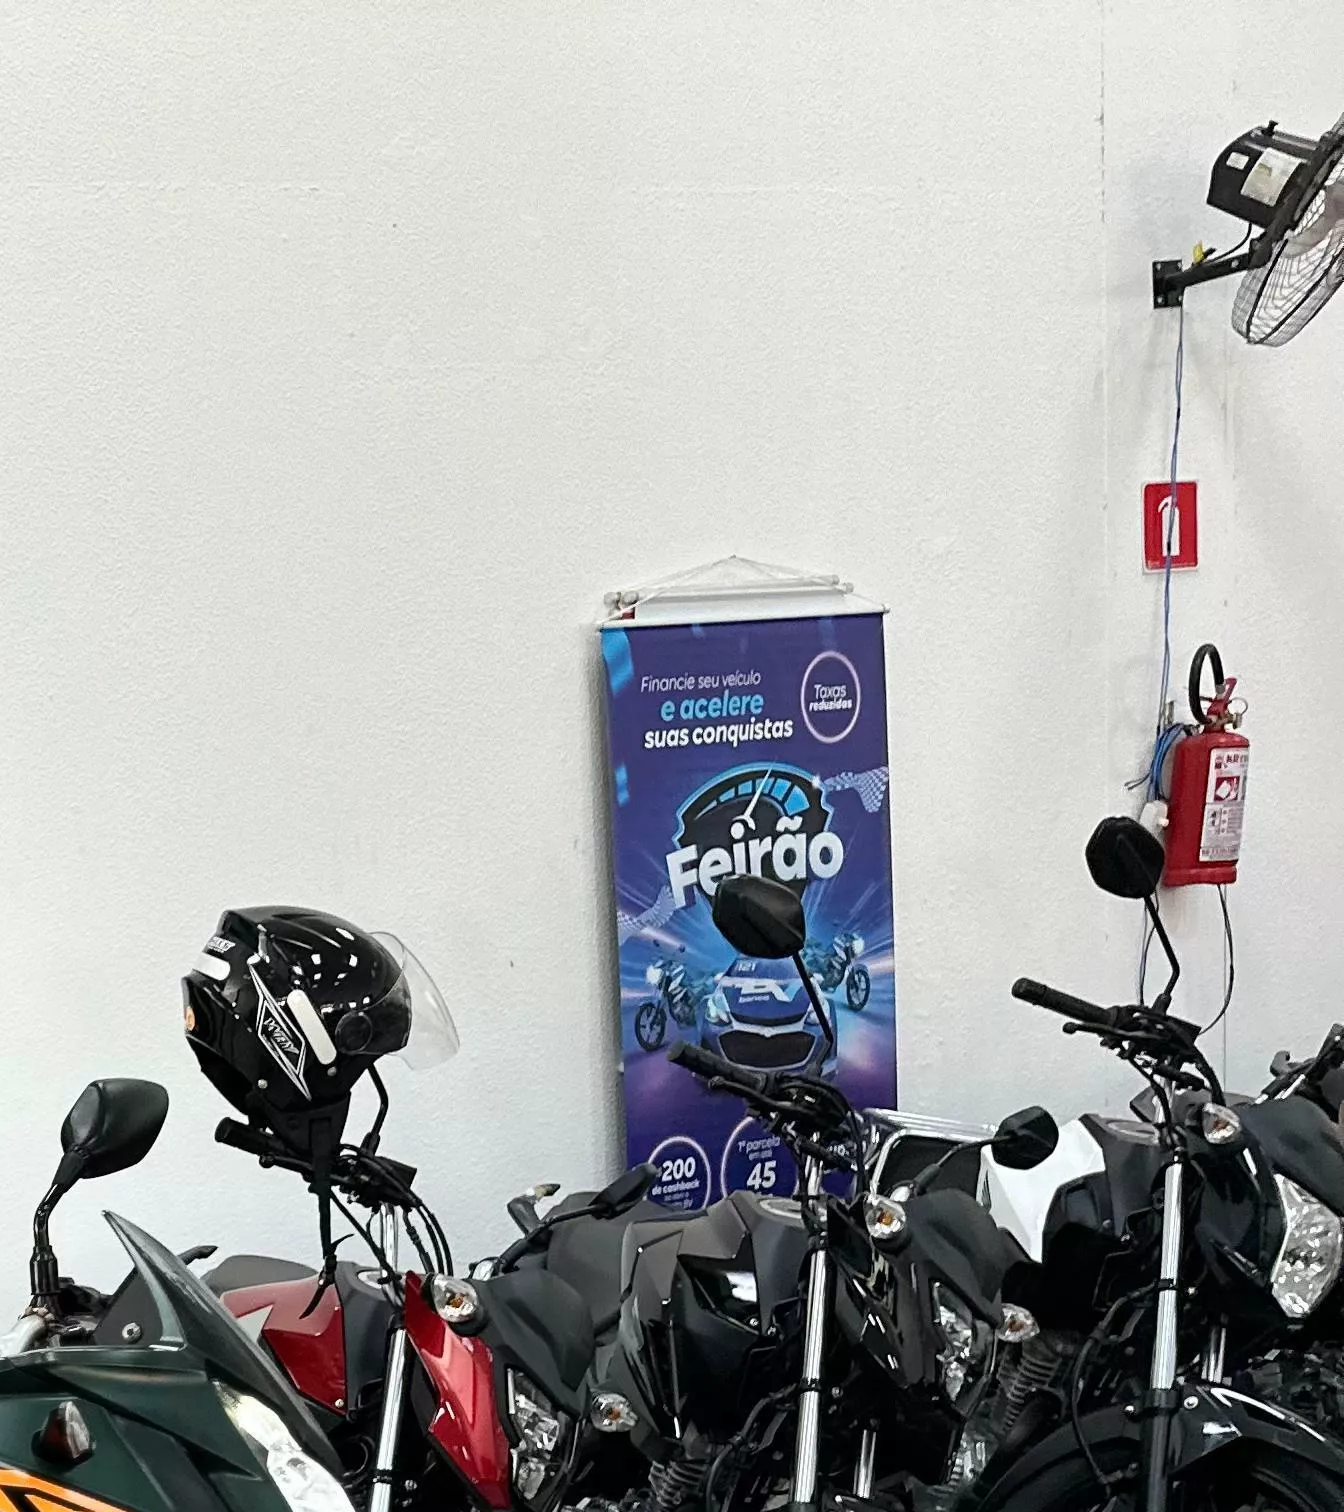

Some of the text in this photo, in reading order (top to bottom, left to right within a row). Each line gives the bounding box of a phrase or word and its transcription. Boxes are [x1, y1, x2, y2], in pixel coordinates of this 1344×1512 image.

[641, 669, 761, 692] Financie seu veículo
[814, 683, 847, 698] Taxas
[661, 690, 764, 721] e acelere
[644, 716, 794, 749] suas conquistas
[666, 815, 845, 909] Feirão
[746, 1160, 777, 1190] 45
